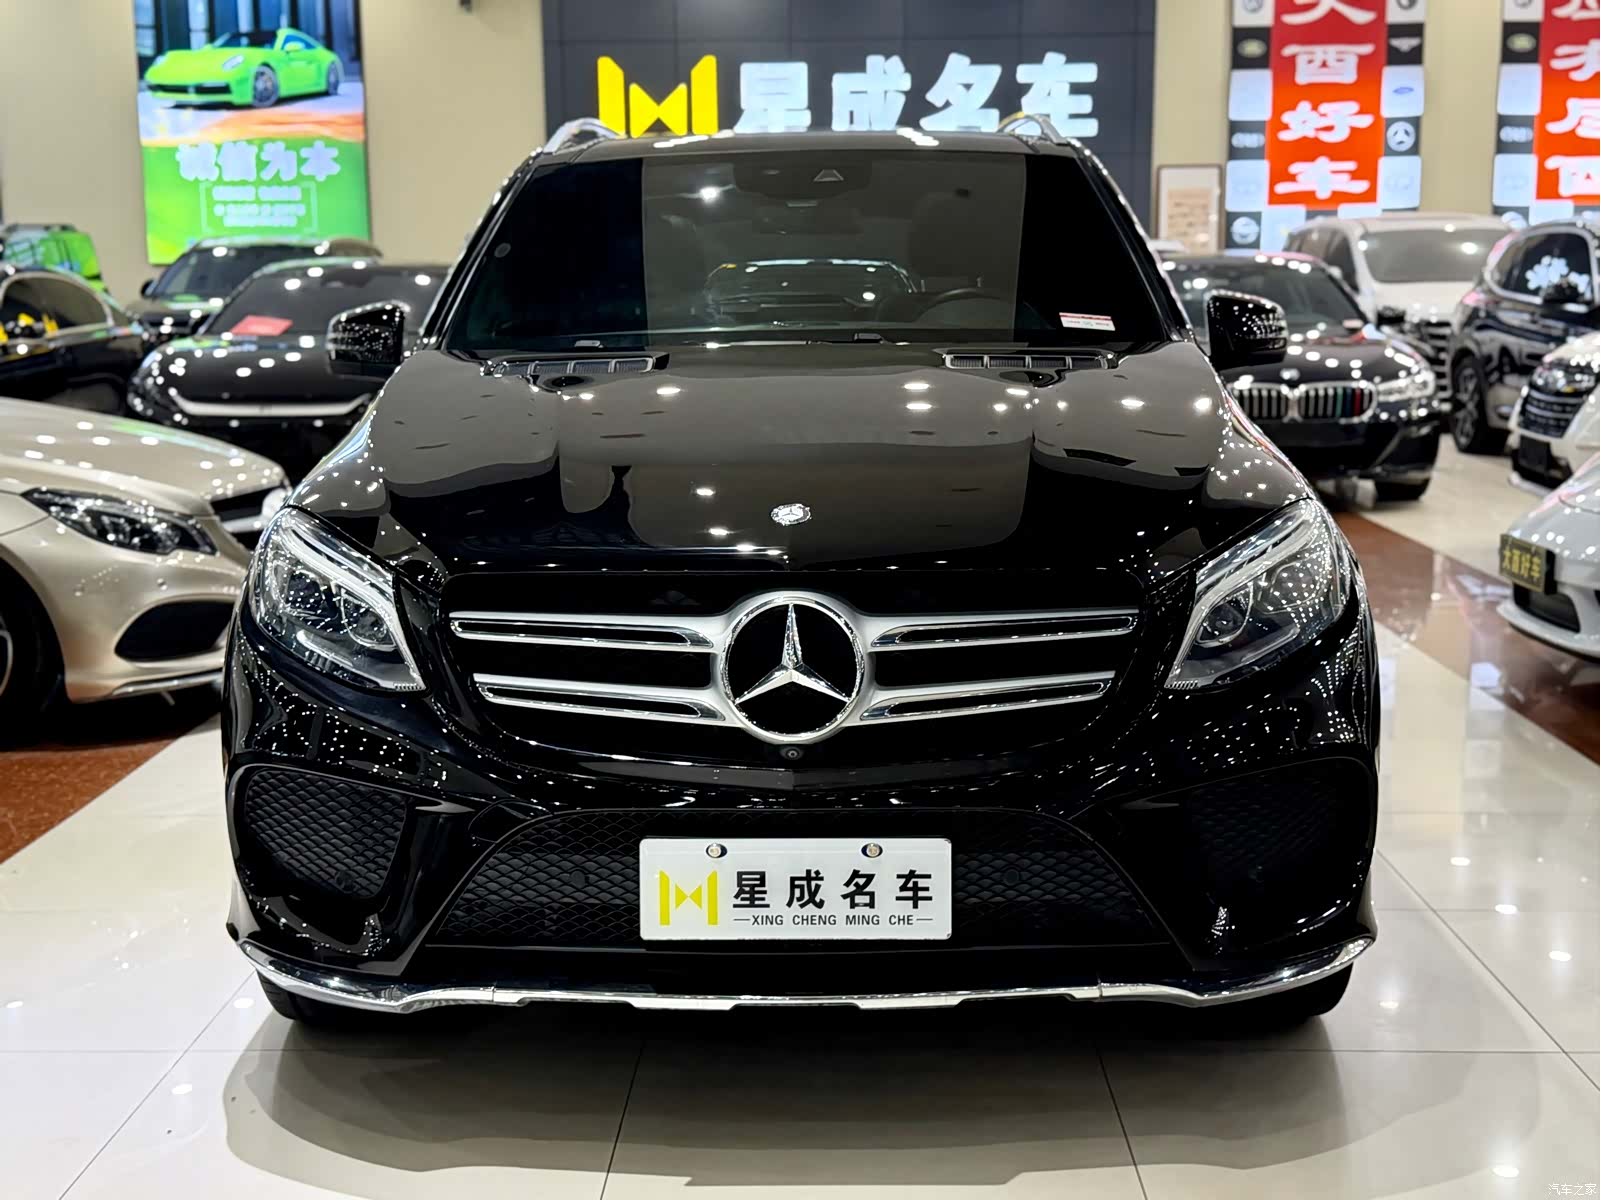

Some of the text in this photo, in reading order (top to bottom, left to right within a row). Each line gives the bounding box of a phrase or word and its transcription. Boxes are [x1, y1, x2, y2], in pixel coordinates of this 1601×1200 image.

[733, 52, 1099, 137] 星成名车
[732, 868, 933, 910] 星成名车
[751, 914, 914, 926] XING CHENG MING CHE
